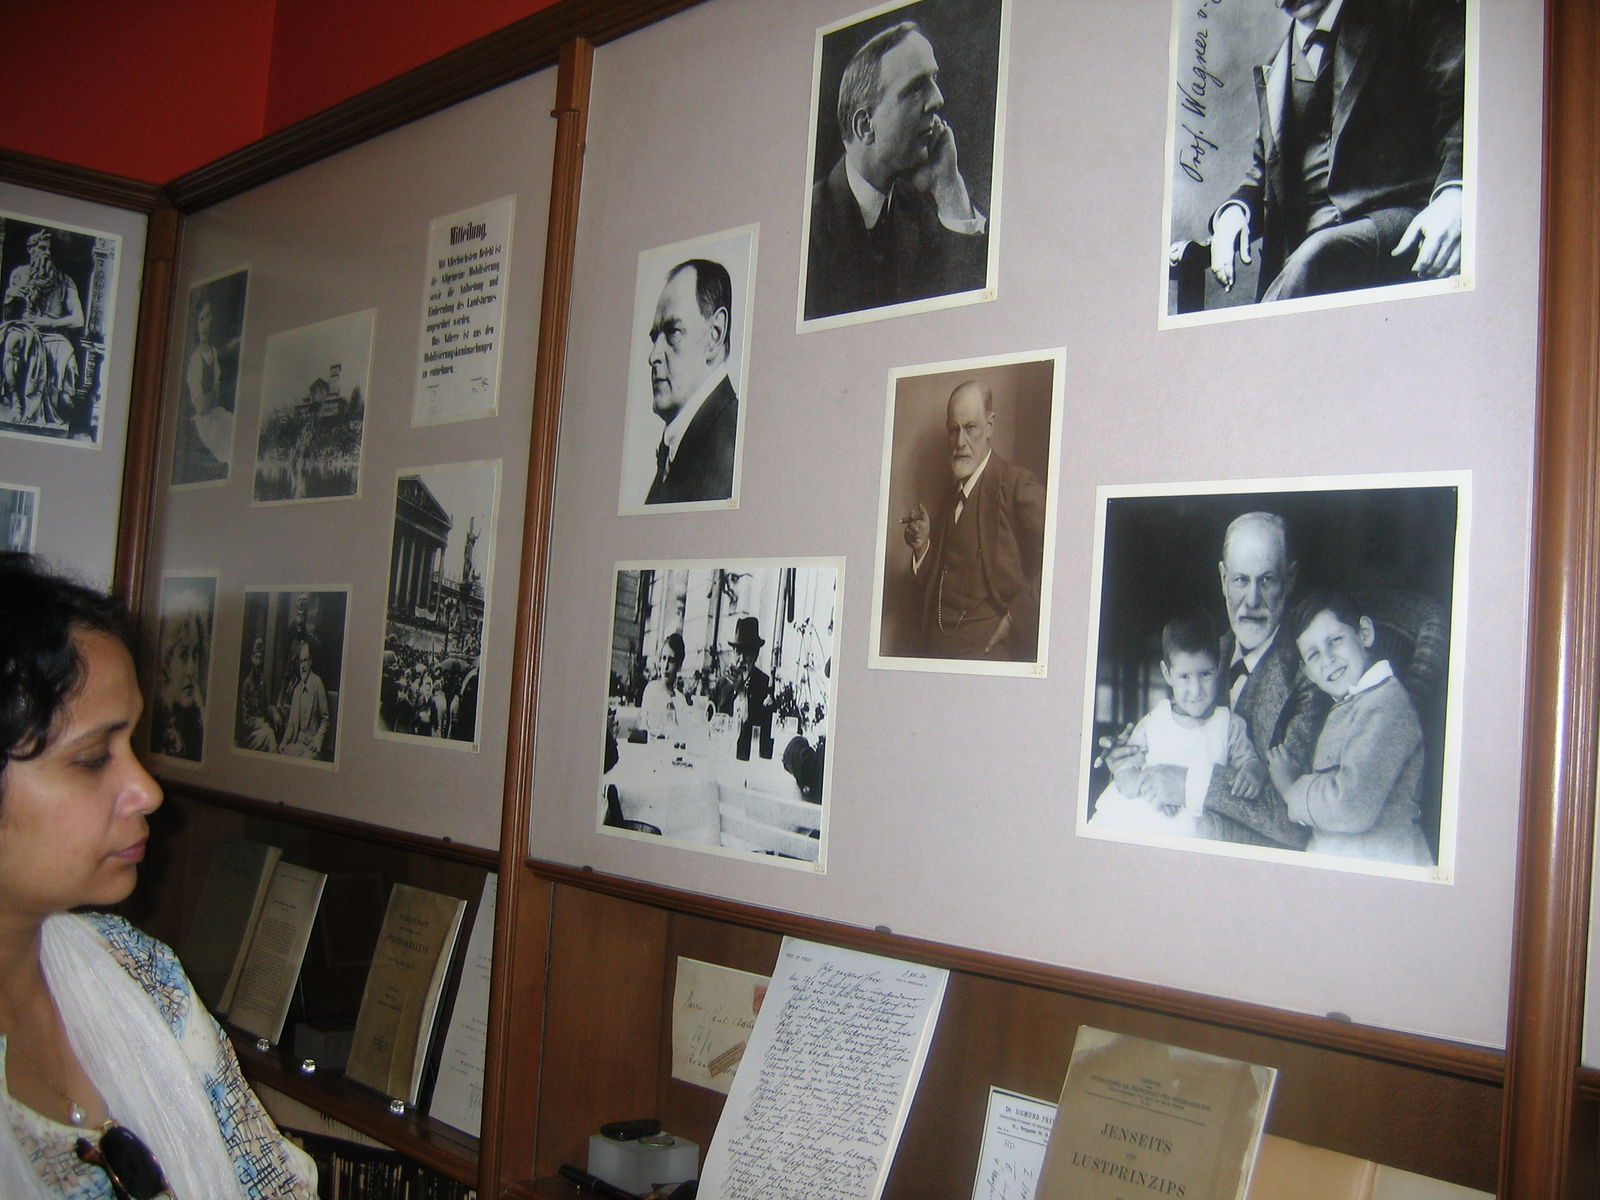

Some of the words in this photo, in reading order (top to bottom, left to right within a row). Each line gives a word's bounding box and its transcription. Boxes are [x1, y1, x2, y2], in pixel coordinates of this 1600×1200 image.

[1176, 29, 1224, 118] Wagner
[1100, 1122, 1173, 1154] JENSEITS
[1071, 1151, 1187, 1199] LUSTPRINZIPS
